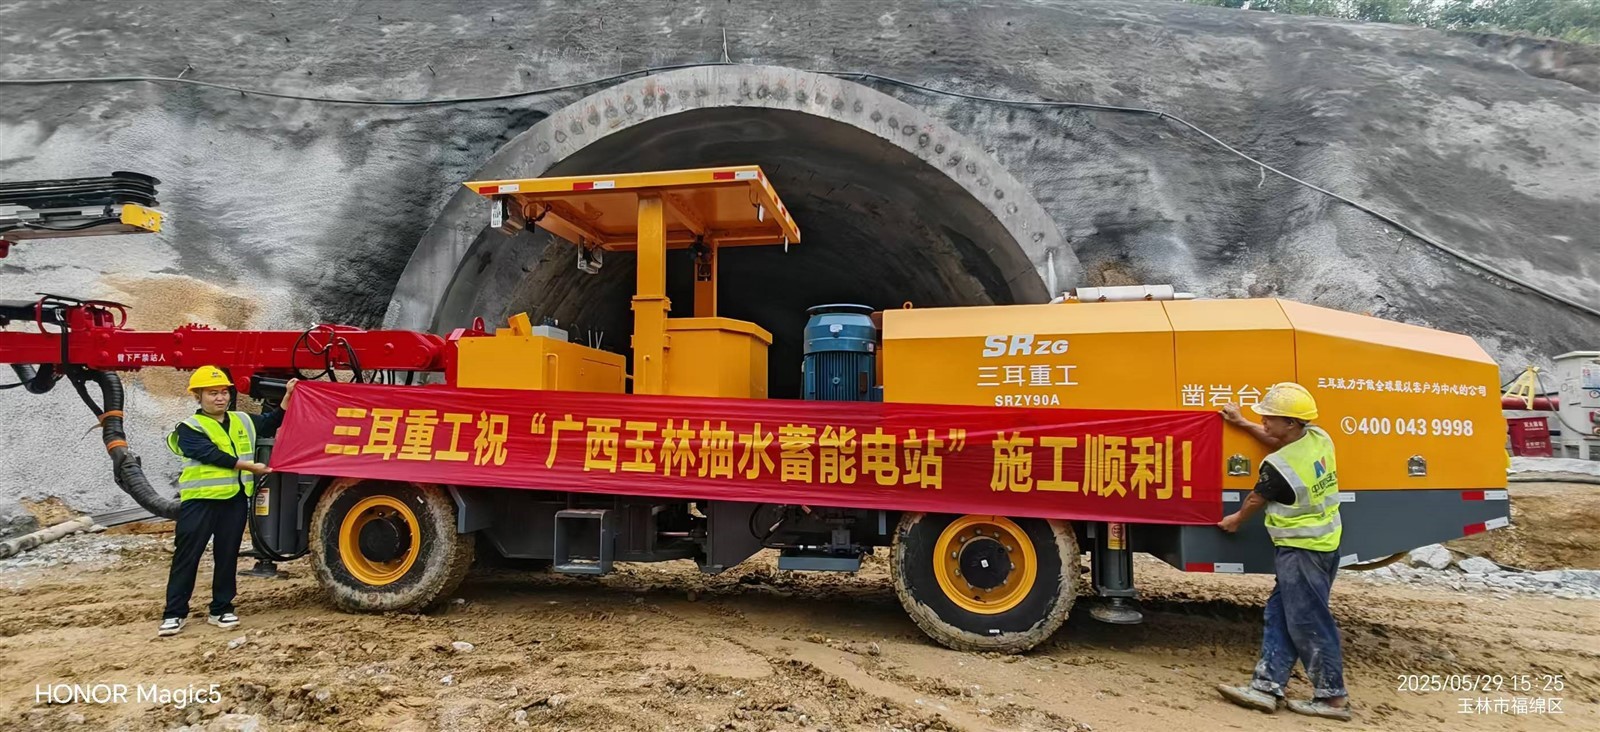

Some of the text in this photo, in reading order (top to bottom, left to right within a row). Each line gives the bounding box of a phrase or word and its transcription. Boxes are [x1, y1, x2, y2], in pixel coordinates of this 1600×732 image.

[976, 364, 1079, 387] 三耳重工
[994, 394, 1060, 407] SRZY90A
[1181, 384, 1277, 407] 凿岩台
[1358, 417, 1474, 437] 400 043 9998
